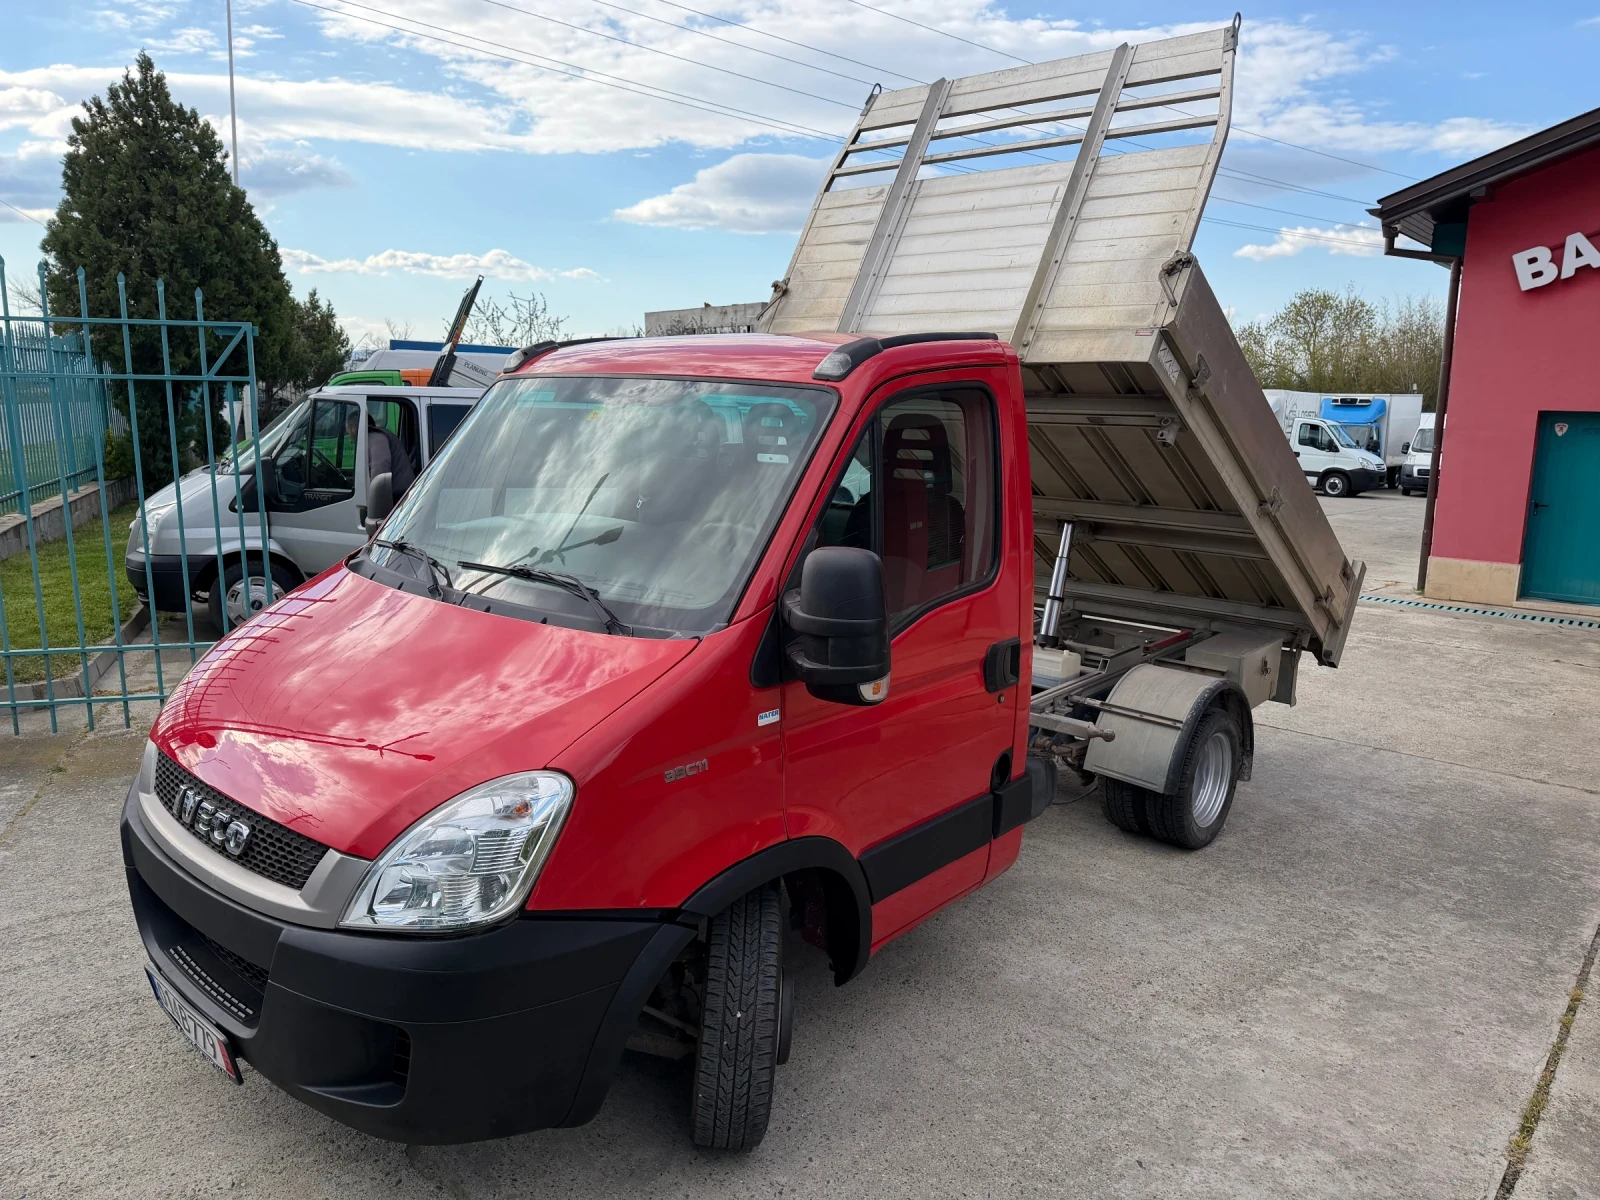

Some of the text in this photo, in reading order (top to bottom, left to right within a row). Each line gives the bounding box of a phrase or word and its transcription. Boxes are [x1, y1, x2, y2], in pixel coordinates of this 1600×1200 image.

[463, 361, 488, 377] PLANUNG
[304, 493, 332, 501] TRANSIT
[172, 784, 252, 856] IVECO
